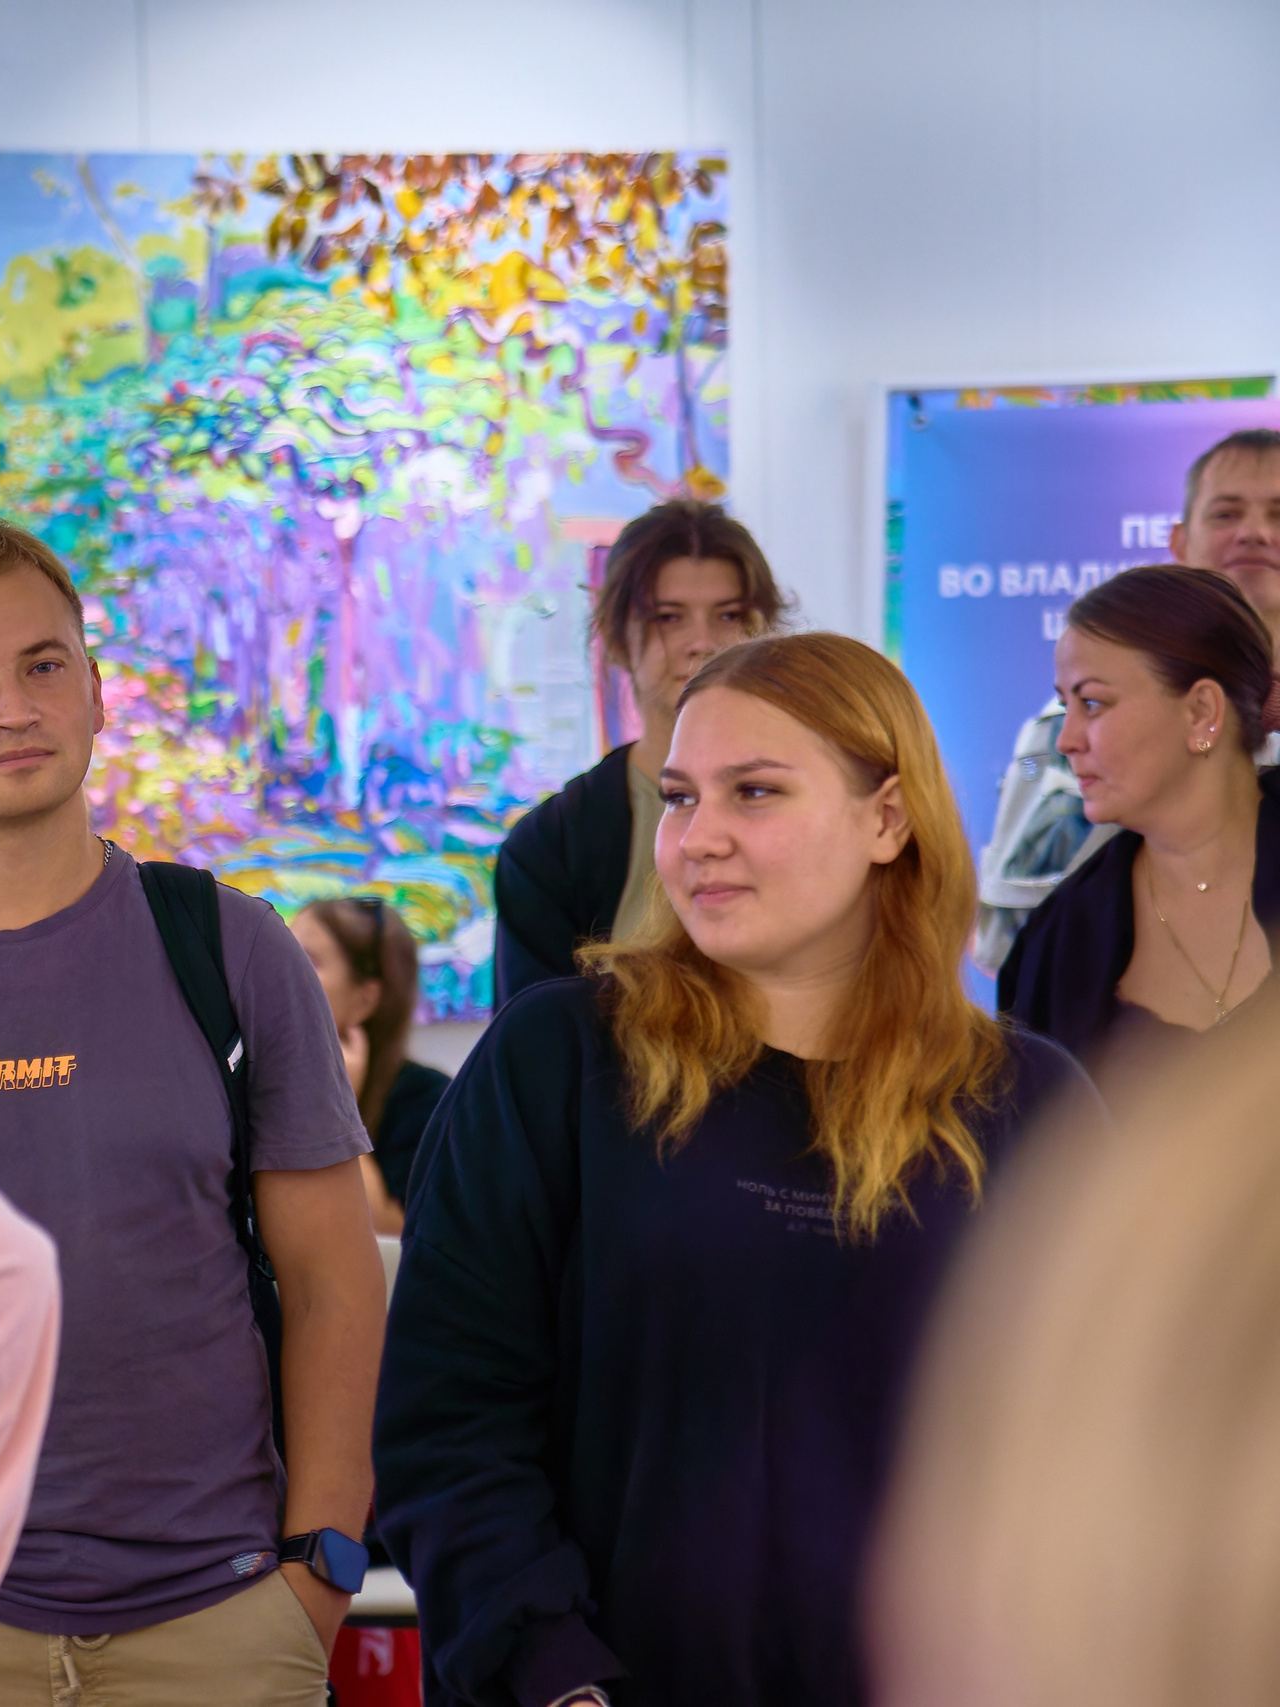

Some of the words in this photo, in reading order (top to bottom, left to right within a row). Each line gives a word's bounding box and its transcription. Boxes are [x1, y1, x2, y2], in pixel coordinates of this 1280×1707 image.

[1122, 515, 1182, 548] ПЕ
[939, 564, 992, 597] ВО
[1000, 563, 1140, 597] ВЛАД
[764, 1200, 781, 1213] ЗА
